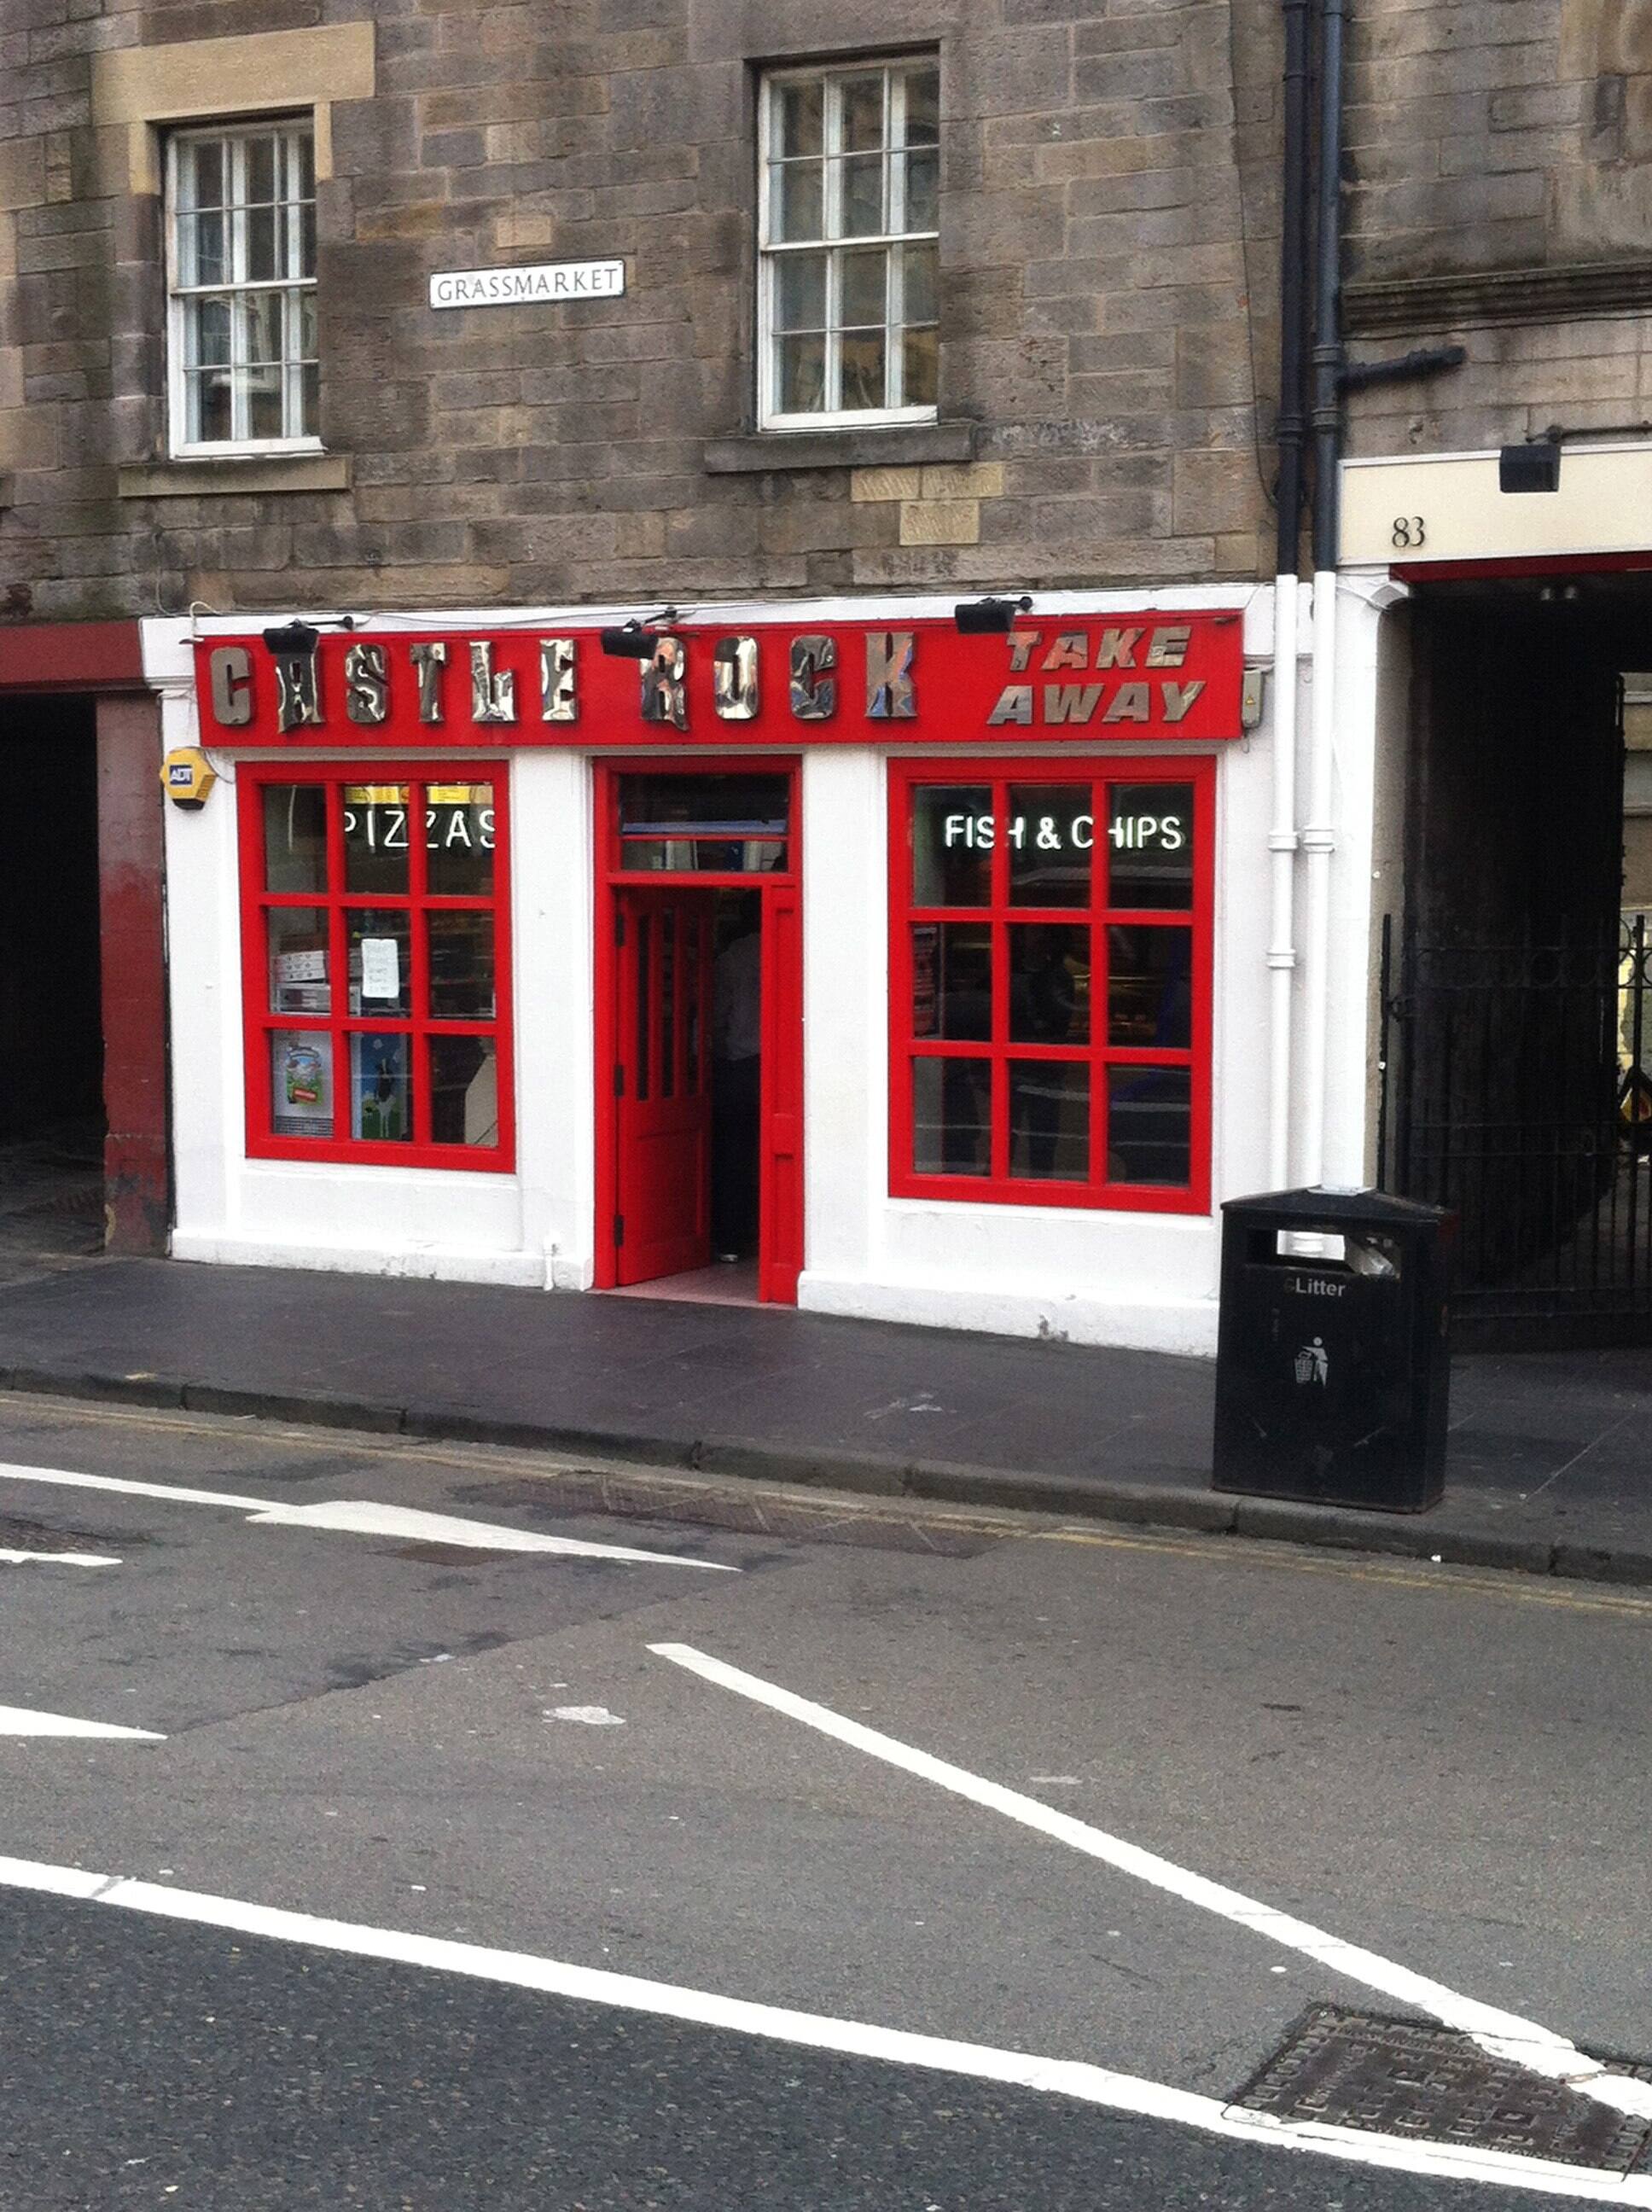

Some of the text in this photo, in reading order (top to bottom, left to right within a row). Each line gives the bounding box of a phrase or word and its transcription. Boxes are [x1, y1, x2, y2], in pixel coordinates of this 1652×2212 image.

[437, 268, 618, 301] GRASSMARKET
[1391, 515, 1425, 548] 83
[1005, 626, 1191, 672] TAKE
[209, 631, 918, 734] CASTLE ROCK
[986, 680, 1206, 725] AWAY
[170, 767, 192, 782] ADT
[945, 815, 1183, 849] FISH & CHIPS
[1295, 1277, 1346, 1297] Litter
